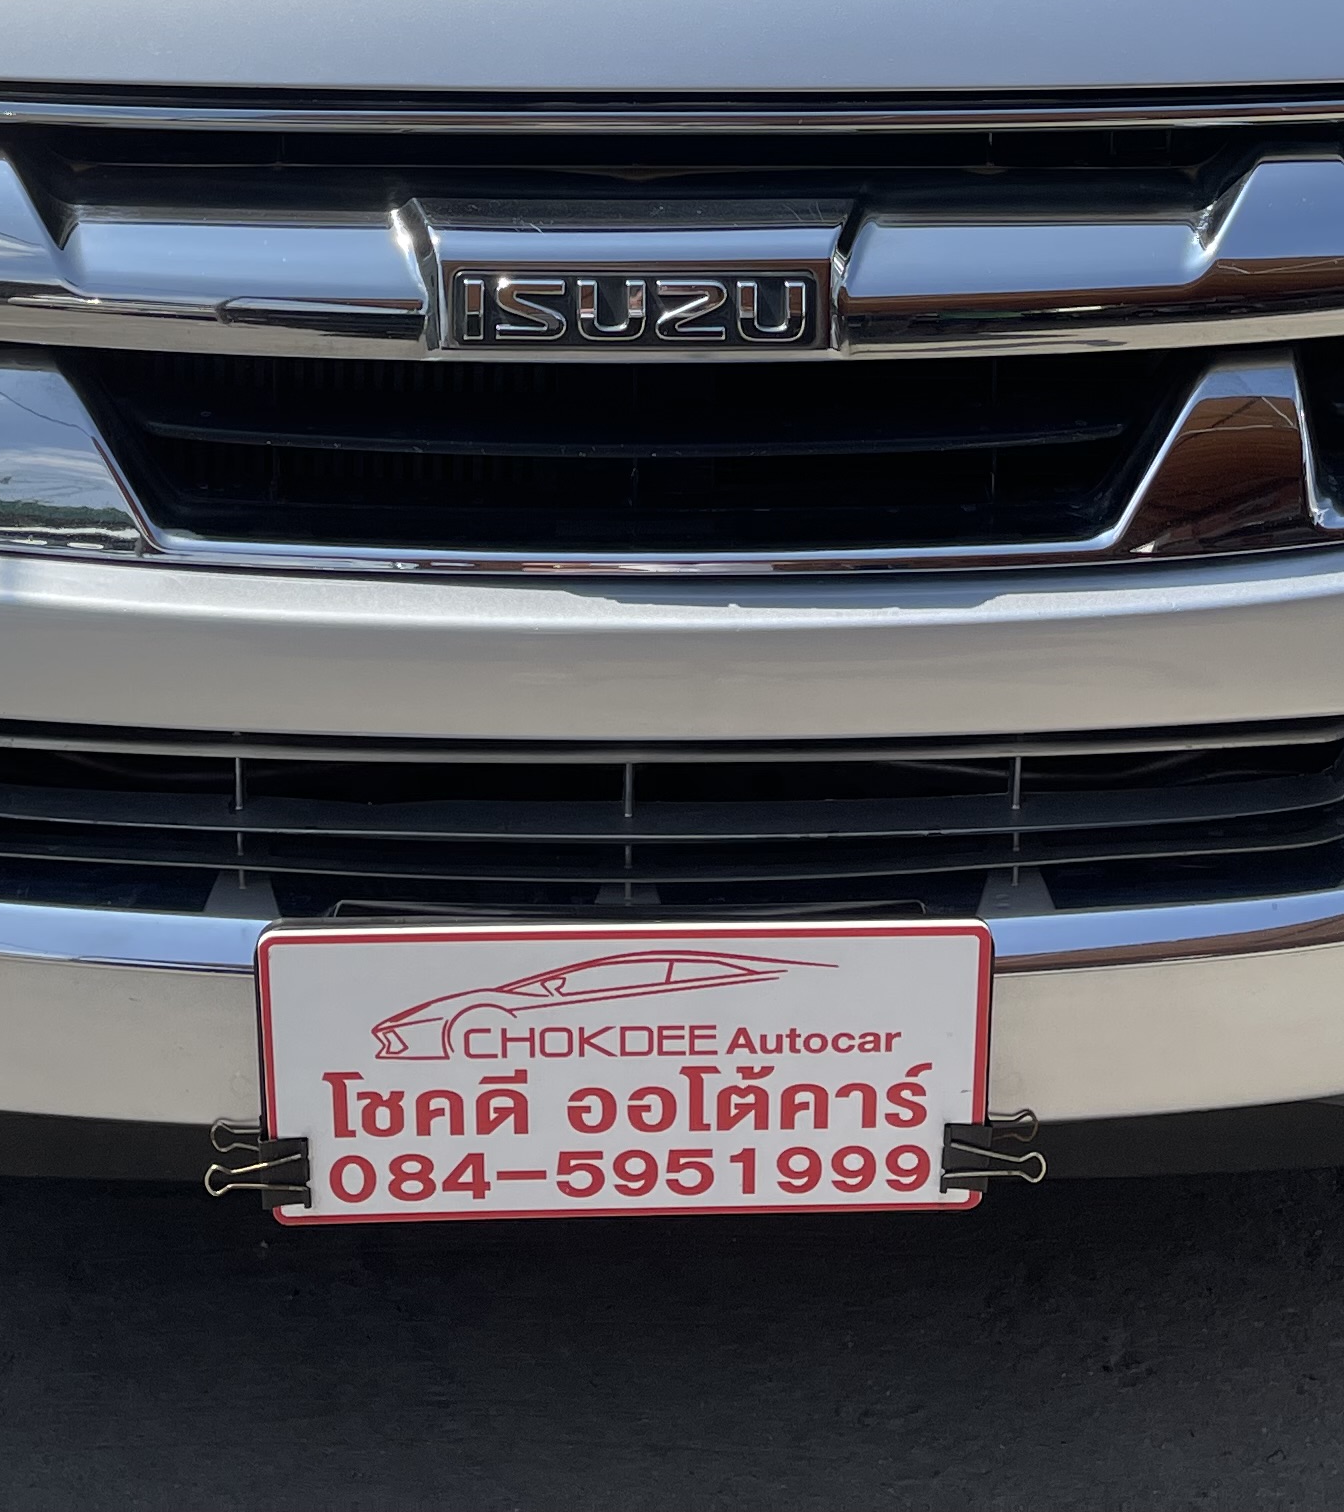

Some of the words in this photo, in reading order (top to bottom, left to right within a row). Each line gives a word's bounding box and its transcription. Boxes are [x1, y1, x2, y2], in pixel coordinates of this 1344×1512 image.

[462, 279, 805, 341] ISUZU
[463, 1024, 718, 1059] CHOKDEE
[726, 1027, 902, 1056] Autocar
[323, 1068, 529, 1138] โชคดี
[566, 1062, 934, 1134] ออโต้คาร์
[329, 1143, 931, 1203] 084-5951999
